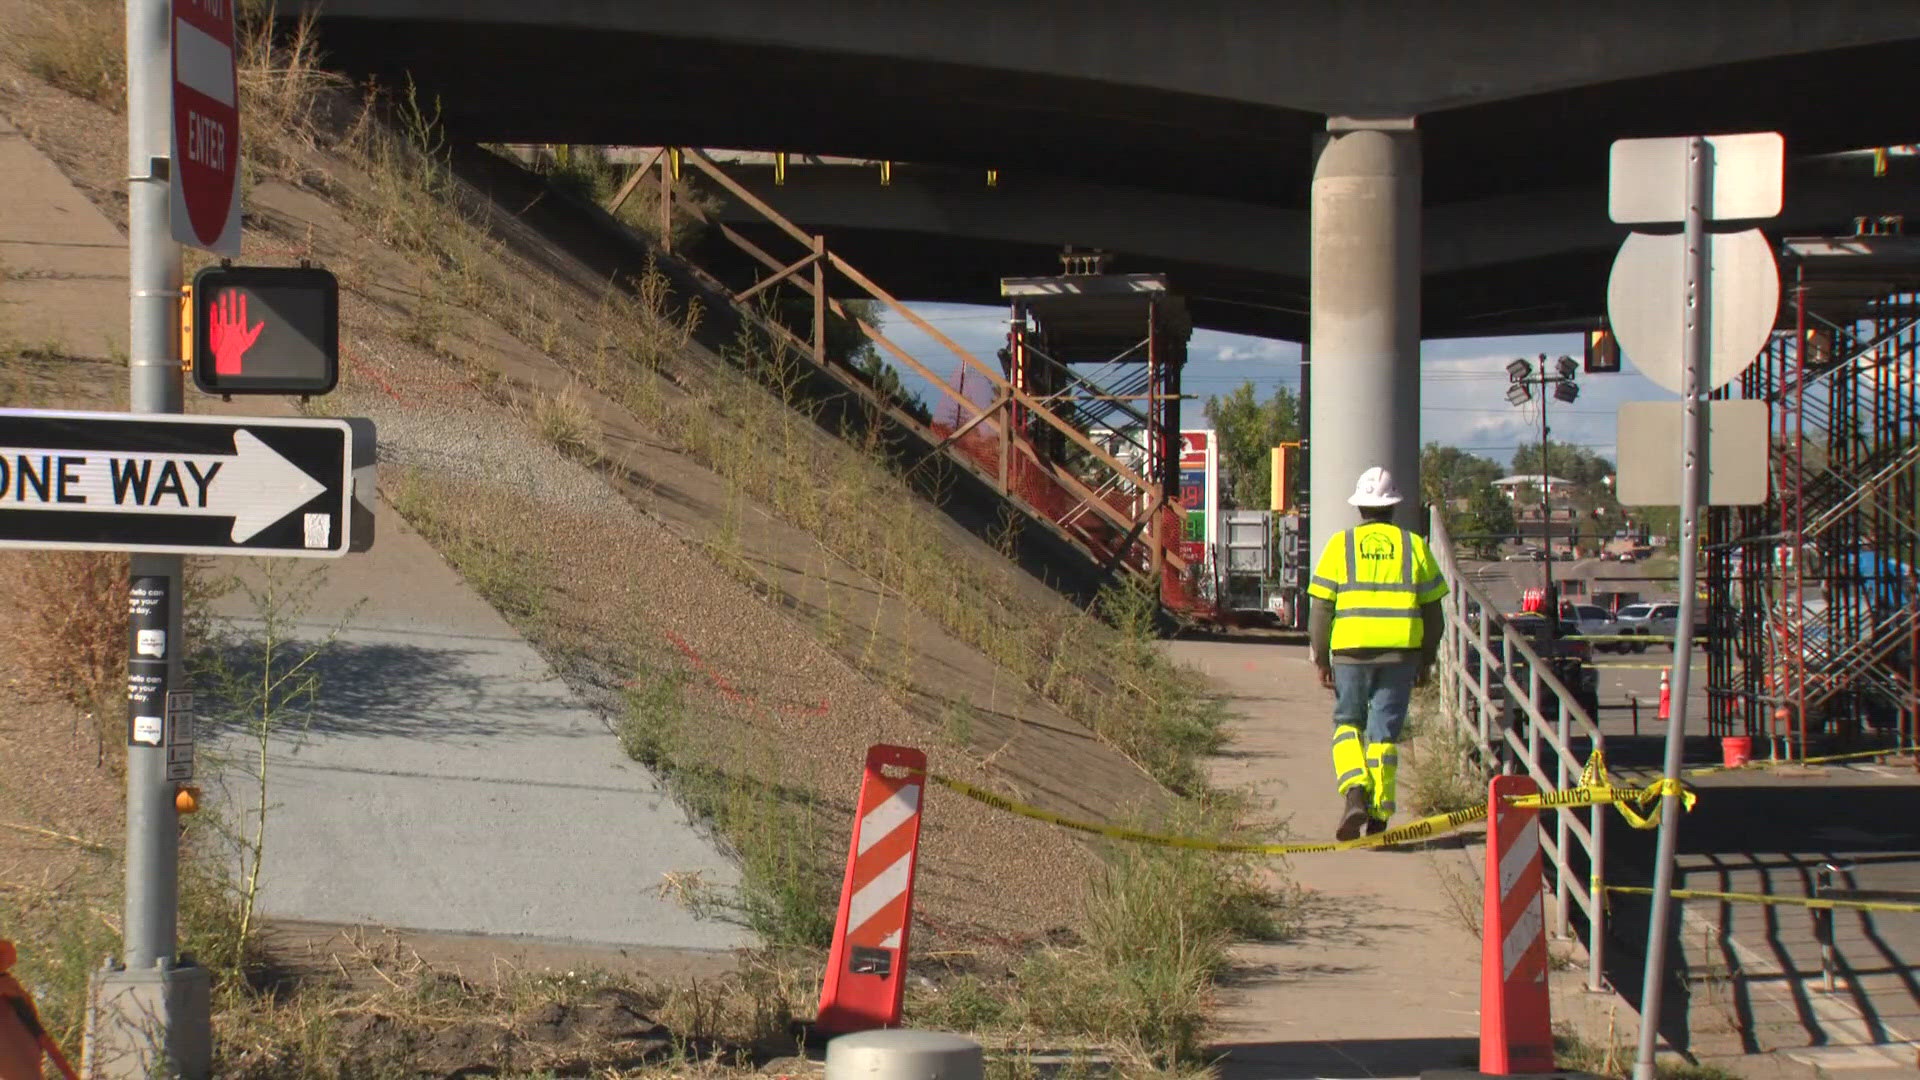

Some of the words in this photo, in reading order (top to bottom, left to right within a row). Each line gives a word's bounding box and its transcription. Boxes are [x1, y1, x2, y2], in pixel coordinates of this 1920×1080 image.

[188, 111, 225, 172] ENTER
[110, 458, 223, 508] WAY
[1540, 788, 1591, 806] CAUTION
[1448, 804, 1488, 827] AUTION
[1383, 821, 1432, 846] CAUTION
